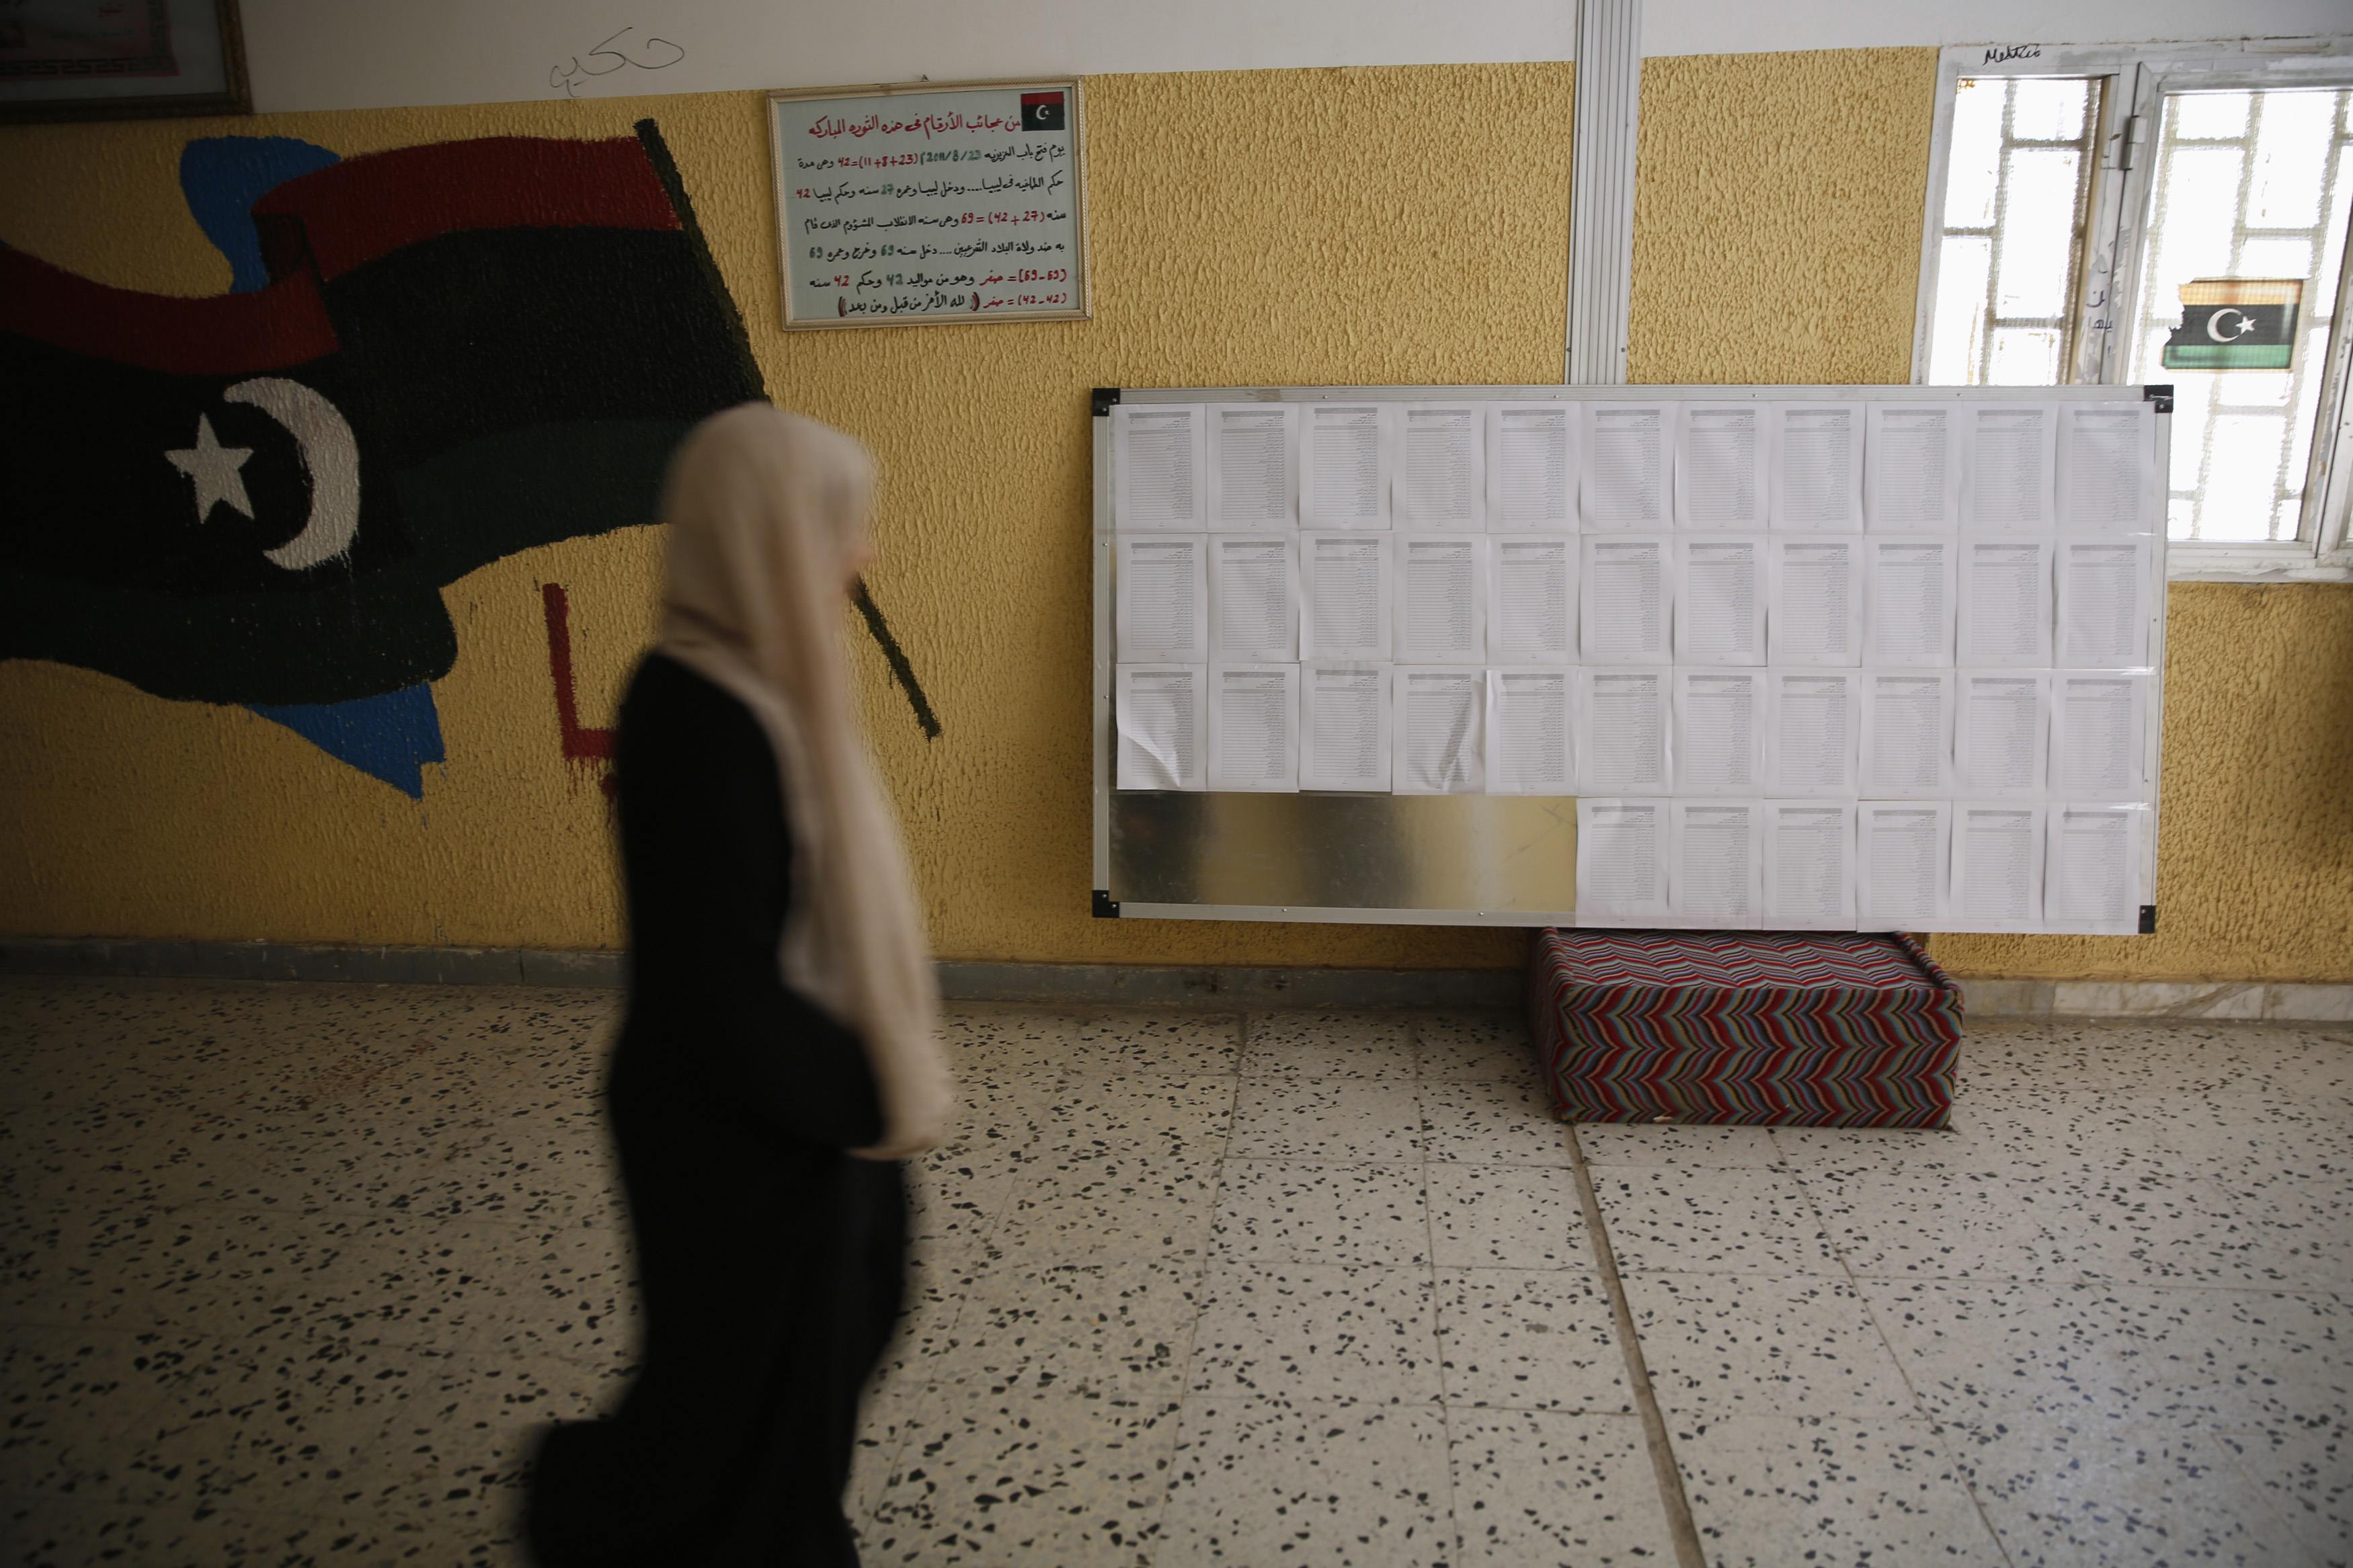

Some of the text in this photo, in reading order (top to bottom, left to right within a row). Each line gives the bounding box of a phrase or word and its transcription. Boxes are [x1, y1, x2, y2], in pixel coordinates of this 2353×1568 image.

[809, 115, 846, 139] المباركه
[881, 120, 904, 134] هذه
[923, 111, 963, 140] الأرقام
[966, 114, 1003, 133] عجائب
[1004, 115, 1022, 132] من
[1016, 143, 1033, 161] باب
[1035, 142, 1047, 161] فتح
[1049, 143, 1066, 162] يوم
[797, 158, 814, 169] مدة
[881, 183, 894, 195] 27
[918, 180, 939, 196] ليبيا
[941, 181, 965, 197] ودخل
[1014, 175, 1043, 192] الطاغيه
[1047, 169, 1064, 196] حكم
[796, 188, 811, 199] 42
[813, 186, 832, 202] ليبيا
[834, 181, 855, 204] وحكم
[859, 185, 879, 196] سنه
[896, 185, 918, 199] وعمره
[918, 216, 939, 224] سنه
[961, 212, 973, 224] 69
[1047, 210, 1066, 220] سنه
[805, 217, 818, 235] قام
[876, 215, 916, 231] الانقلاب
[809, 247, 823, 259] 69
[827, 247, 850, 261] وعمره
[852, 242, 877, 259] وخرج
[881, 244, 894, 256] 69
[896, 246, 917, 255] سنه
[920, 244, 937, 259] دخل
[991, 241, 1014, 255] البلاد
[1016, 240, 1035, 255] ولاة
[1037, 242, 1052, 252] ضد
[1055, 243, 1065, 253] به
[809, 278, 830, 288] سنه
[834, 275, 850, 287] 42
[856, 270, 882, 295] وحكم
[886, 273, 904, 286] 42
[906, 273, 932, 288] مواليد
[936, 273, 949, 286] من
[949, 274, 975, 286] وهو
[979, 270, 1004, 286] صفر
[870, 299, 887, 313] ومن
[890, 296, 909, 314] قبل
[910, 297, 922, 310] من
[983, 296, 1004, 308] صفر
